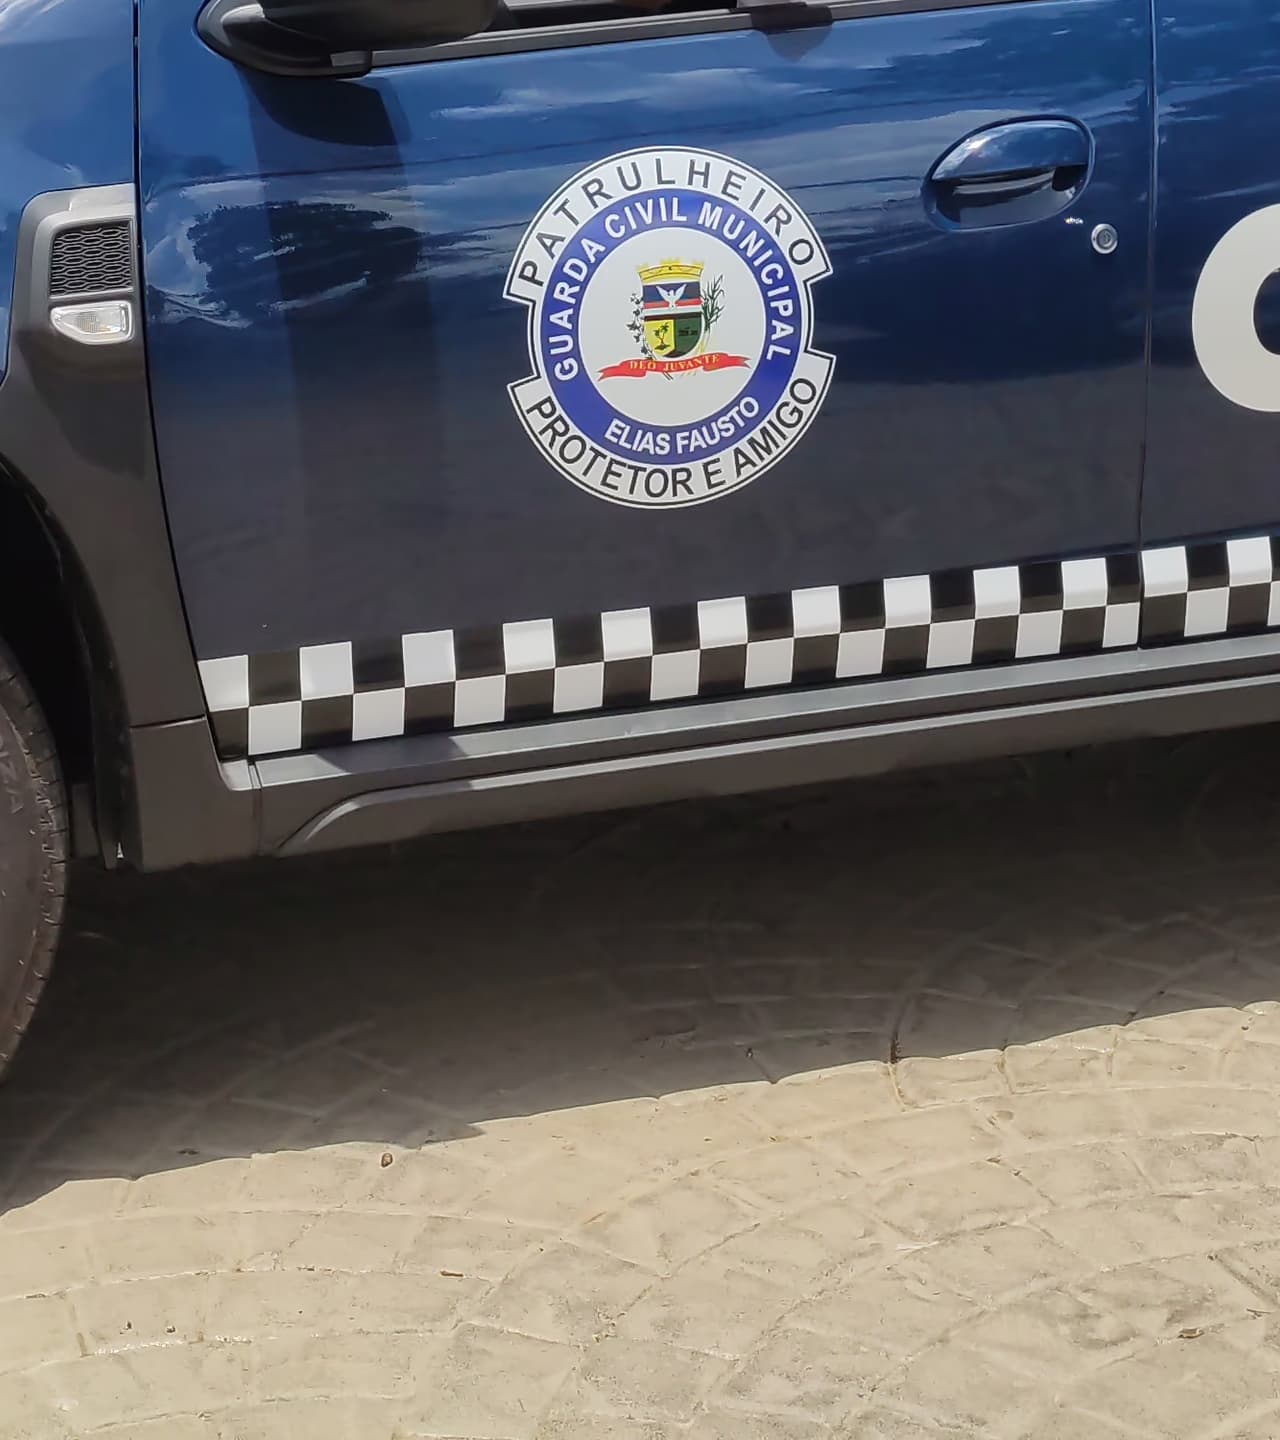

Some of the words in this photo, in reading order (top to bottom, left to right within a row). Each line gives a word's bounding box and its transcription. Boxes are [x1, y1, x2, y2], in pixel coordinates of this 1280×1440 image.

[518, 157, 815, 288] PATRULHEIRO
[550, 237, 607, 383] GUARDA
[604, 196, 688, 240] CIVIL
[696, 201, 796, 362] MUNICIPAL
[662, 353, 720, 372] JUVANTE
[526, 395, 695, 499] PROTETOR
[702, 457, 727, 490] E
[733, 375, 817, 479] AMIGO
[603, 417, 671, 456] ELIAS
[675, 395, 760, 455] FAUSTO
